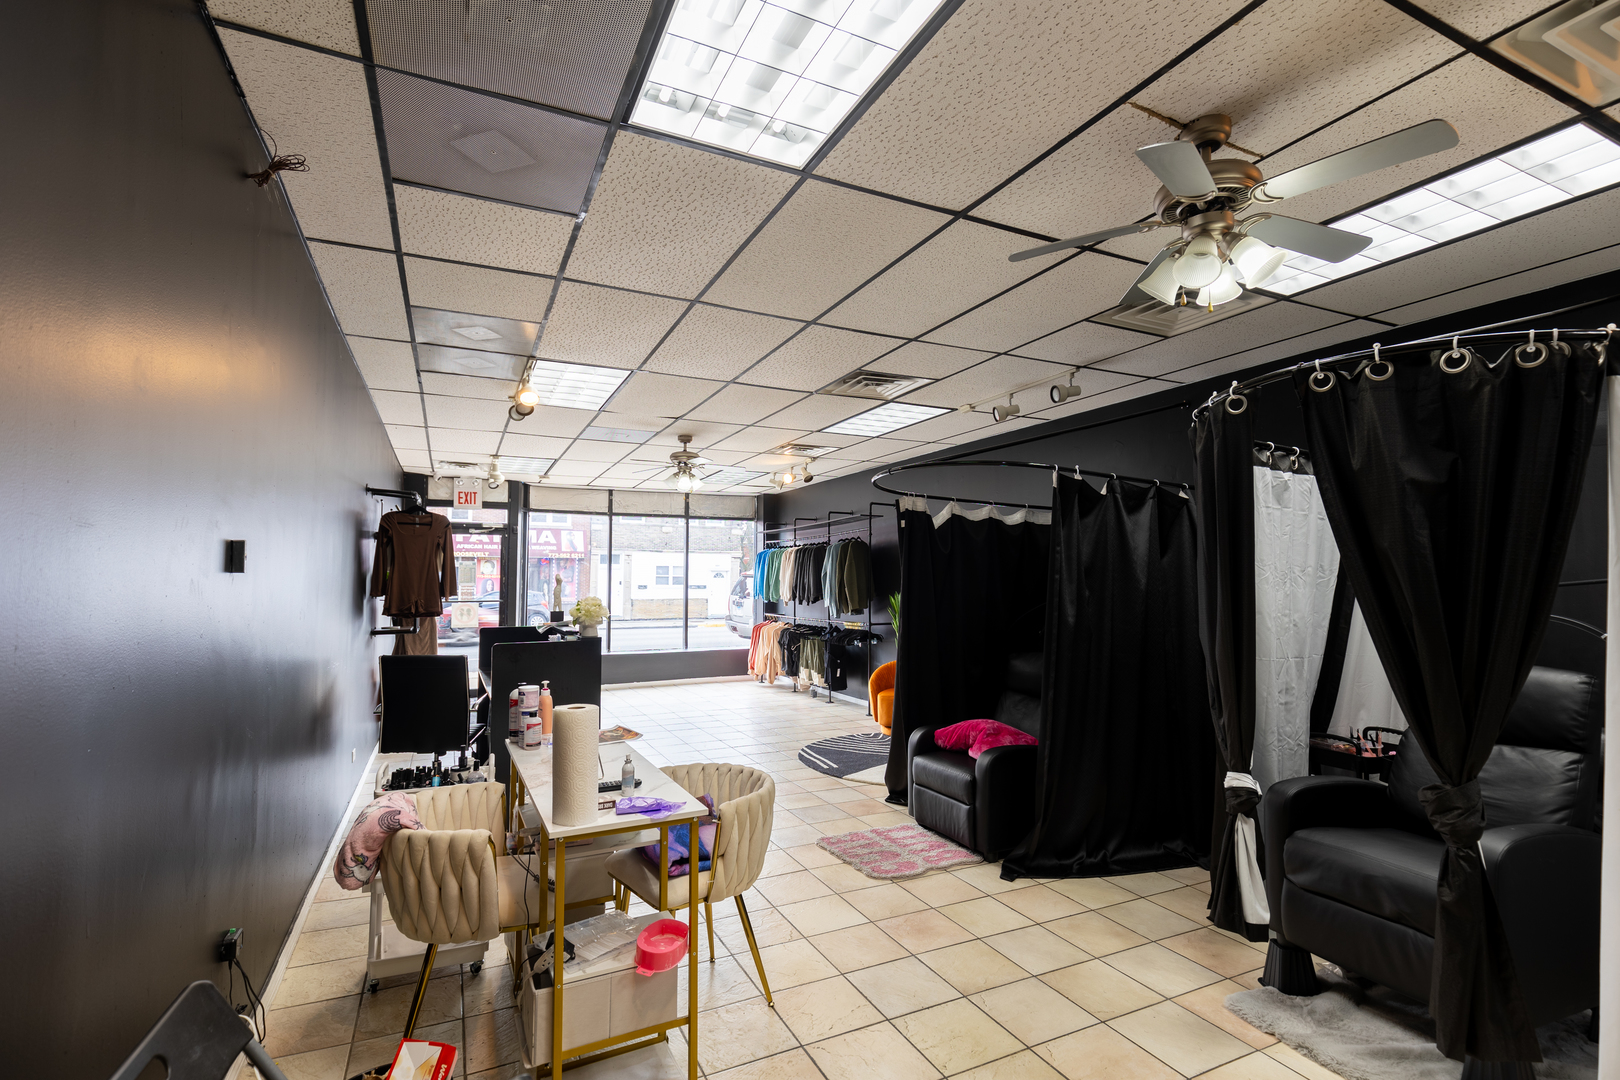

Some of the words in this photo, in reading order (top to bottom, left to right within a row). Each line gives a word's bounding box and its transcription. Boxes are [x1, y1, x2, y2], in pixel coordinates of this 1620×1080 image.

[458, 491, 478, 505] EXIT
[820, 832, 919, 874] CUTE
[870, 825, 975, 865] BUTT
